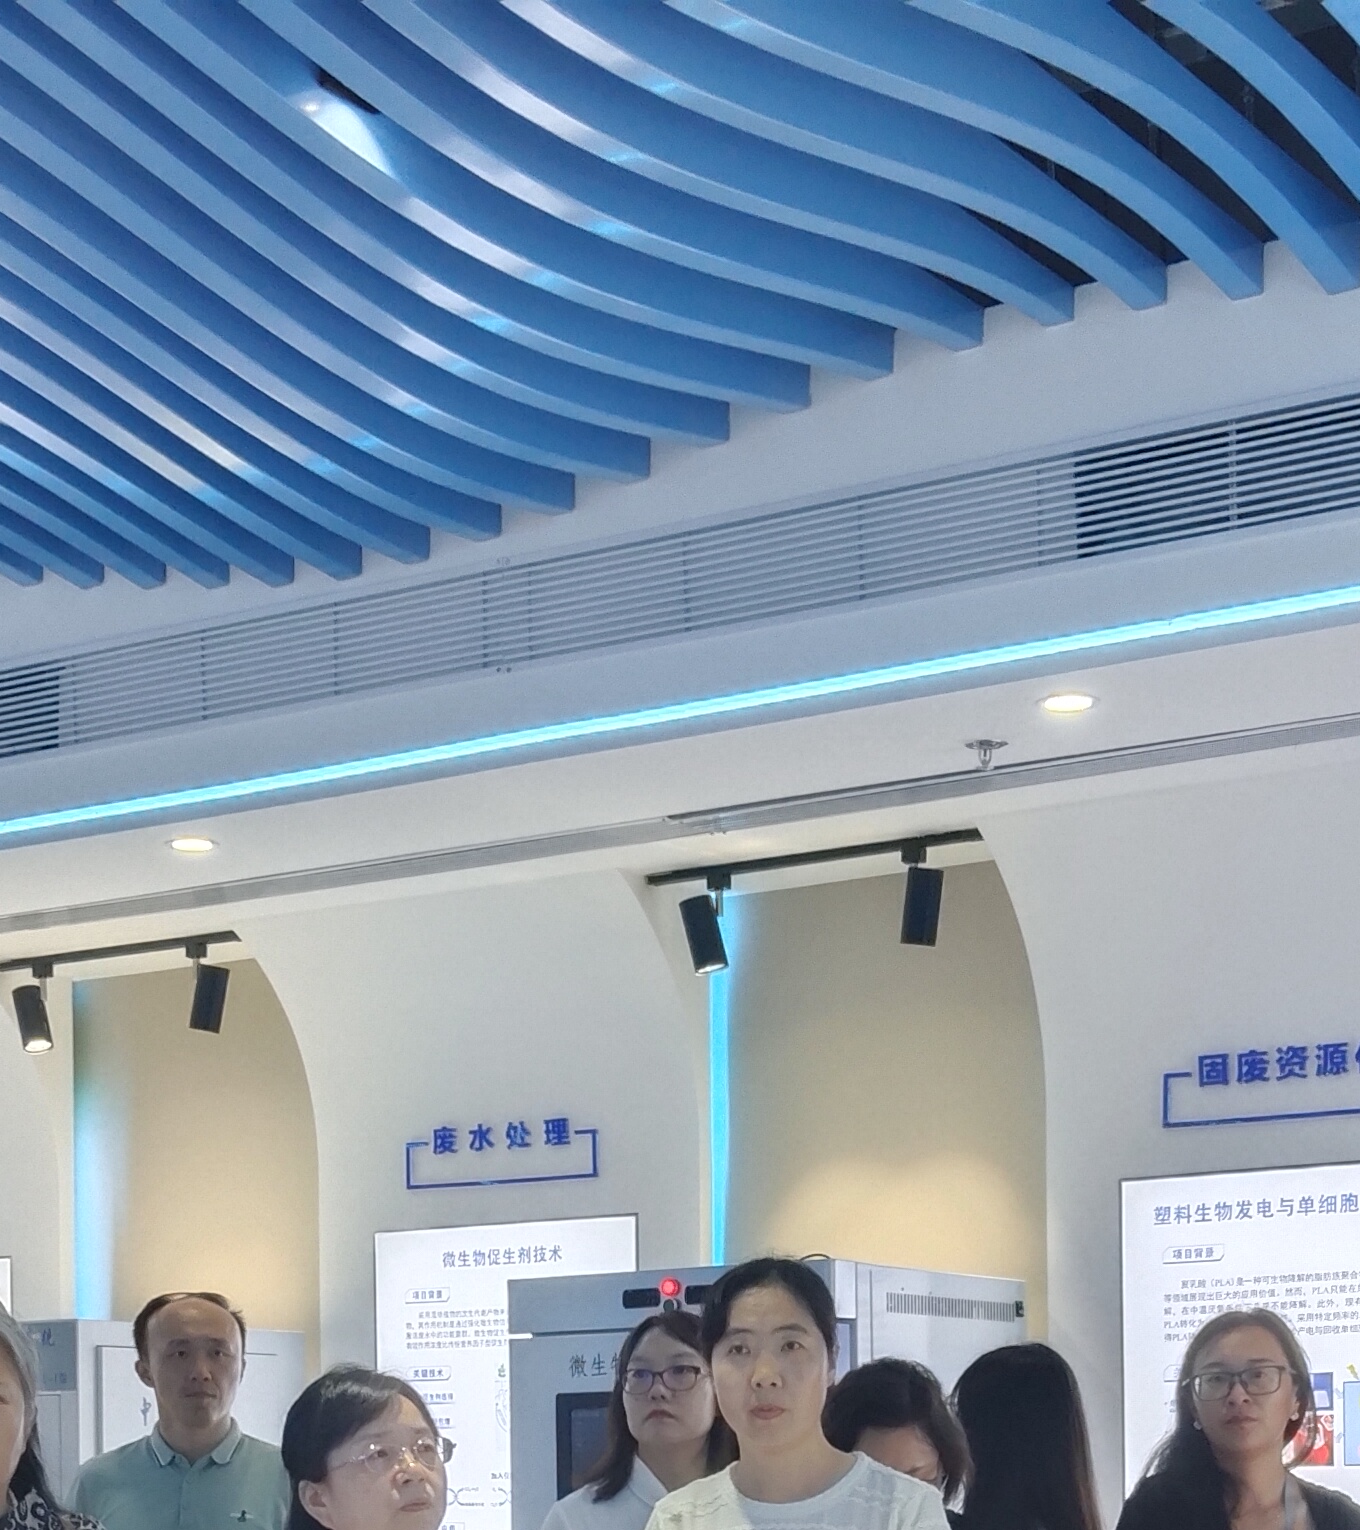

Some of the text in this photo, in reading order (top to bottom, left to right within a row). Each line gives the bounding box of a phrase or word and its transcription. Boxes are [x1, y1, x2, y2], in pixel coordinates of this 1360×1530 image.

[432, 1117, 571, 1155] 废水处理
[442, 1244, 563, 1269] 微生物促生剂技术
[1172, 1247, 1214, 1260] 项目背景
